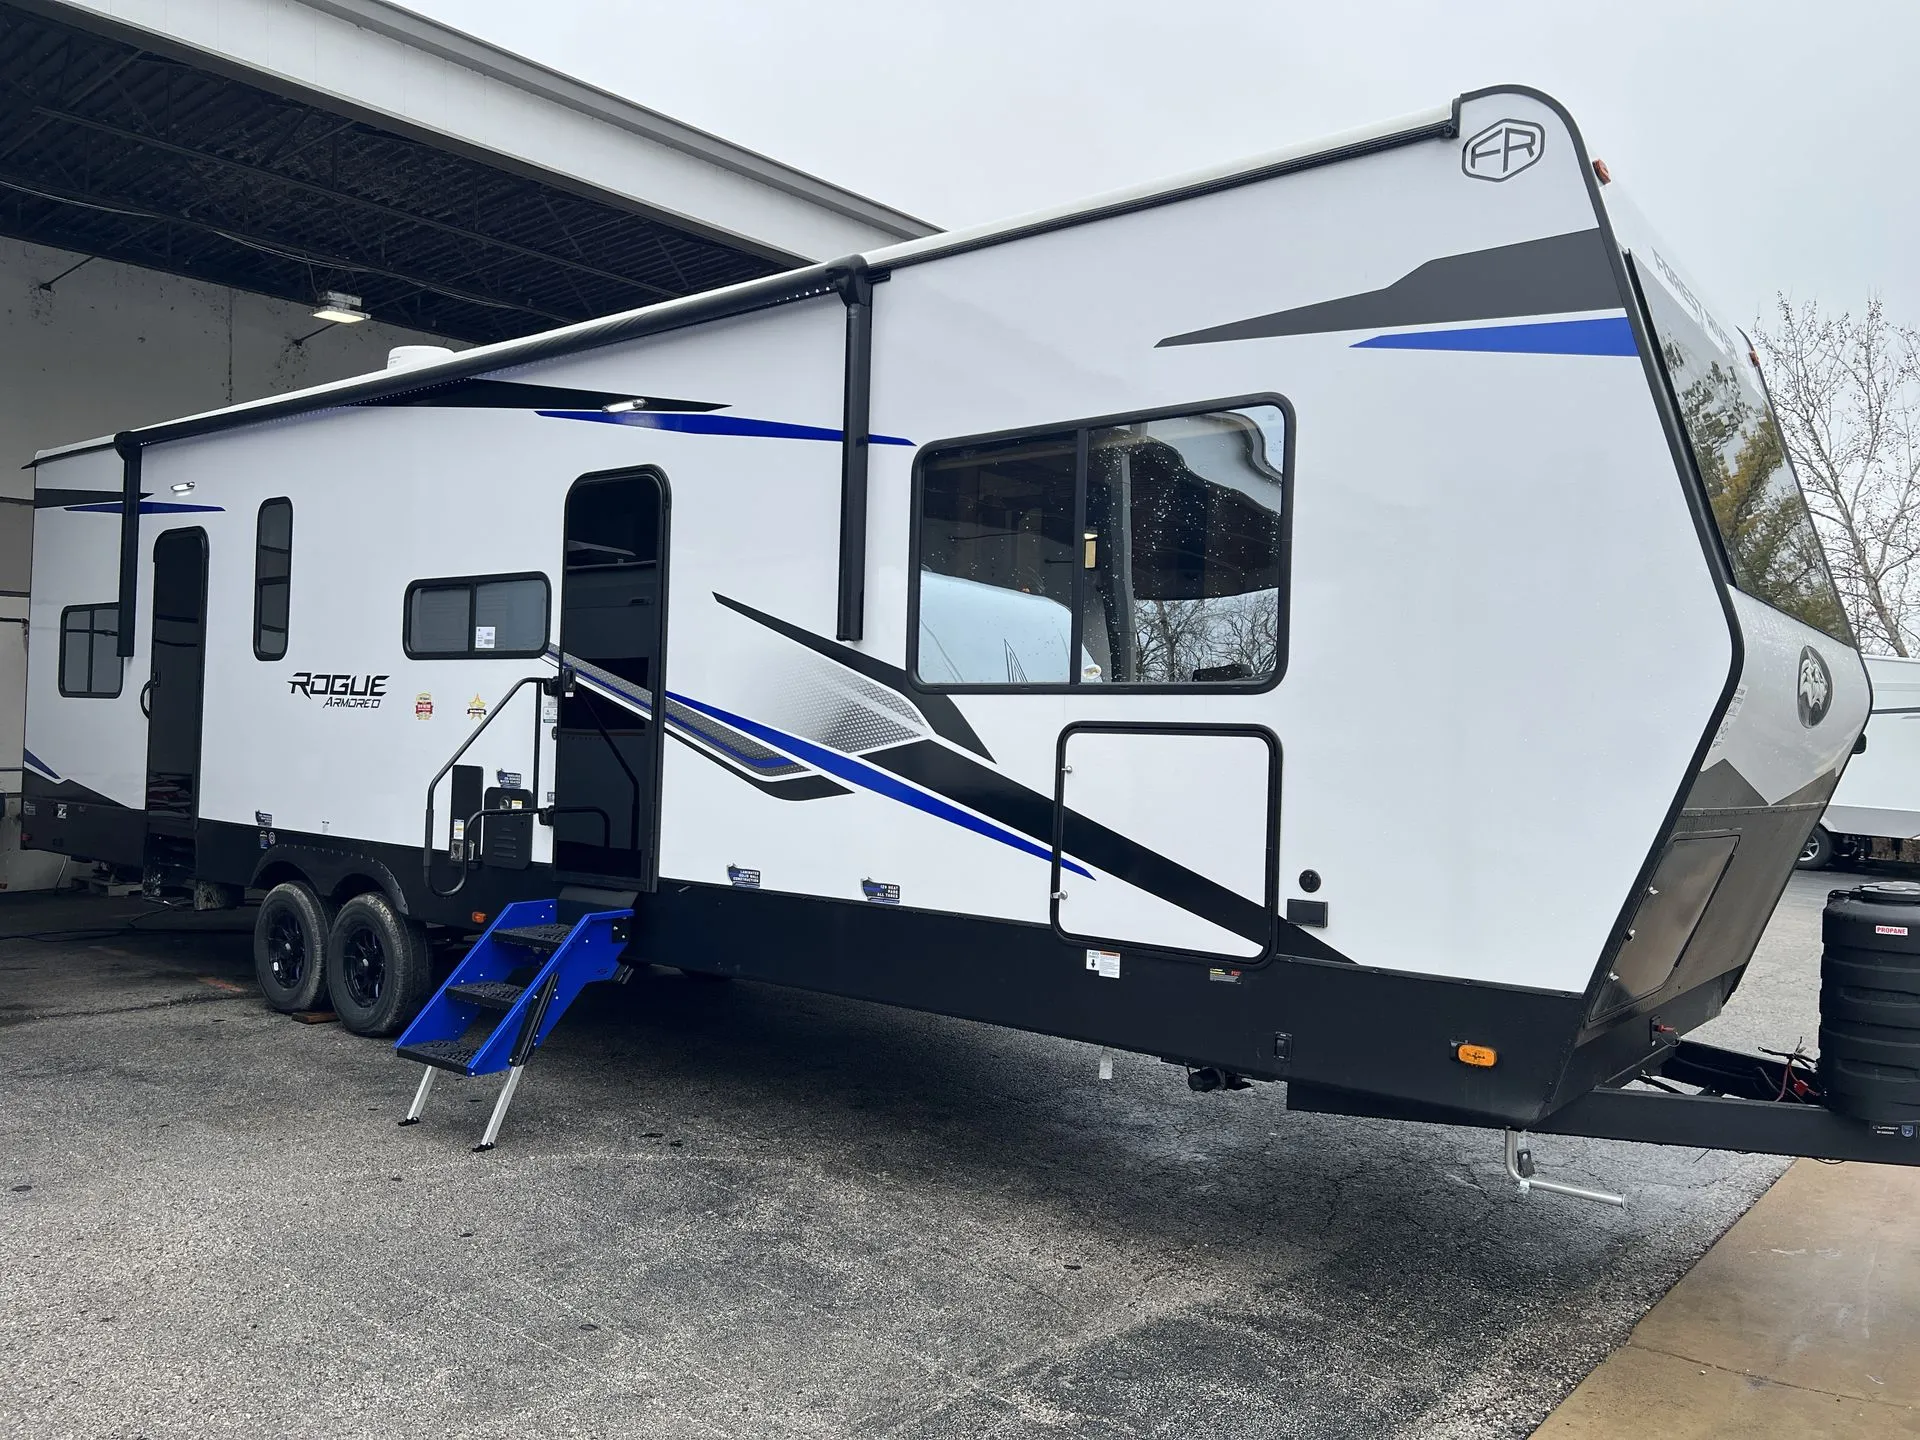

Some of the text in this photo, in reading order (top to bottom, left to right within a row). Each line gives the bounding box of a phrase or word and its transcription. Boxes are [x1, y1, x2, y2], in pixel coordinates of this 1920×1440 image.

[1470, 127, 1536, 174] FR
[1650, 246, 1704, 321] FOREST
[287, 672, 390, 700] ROGUE
[323, 697, 382, 709] ARMORED
[1876, 926, 1907, 935] PROPANE
